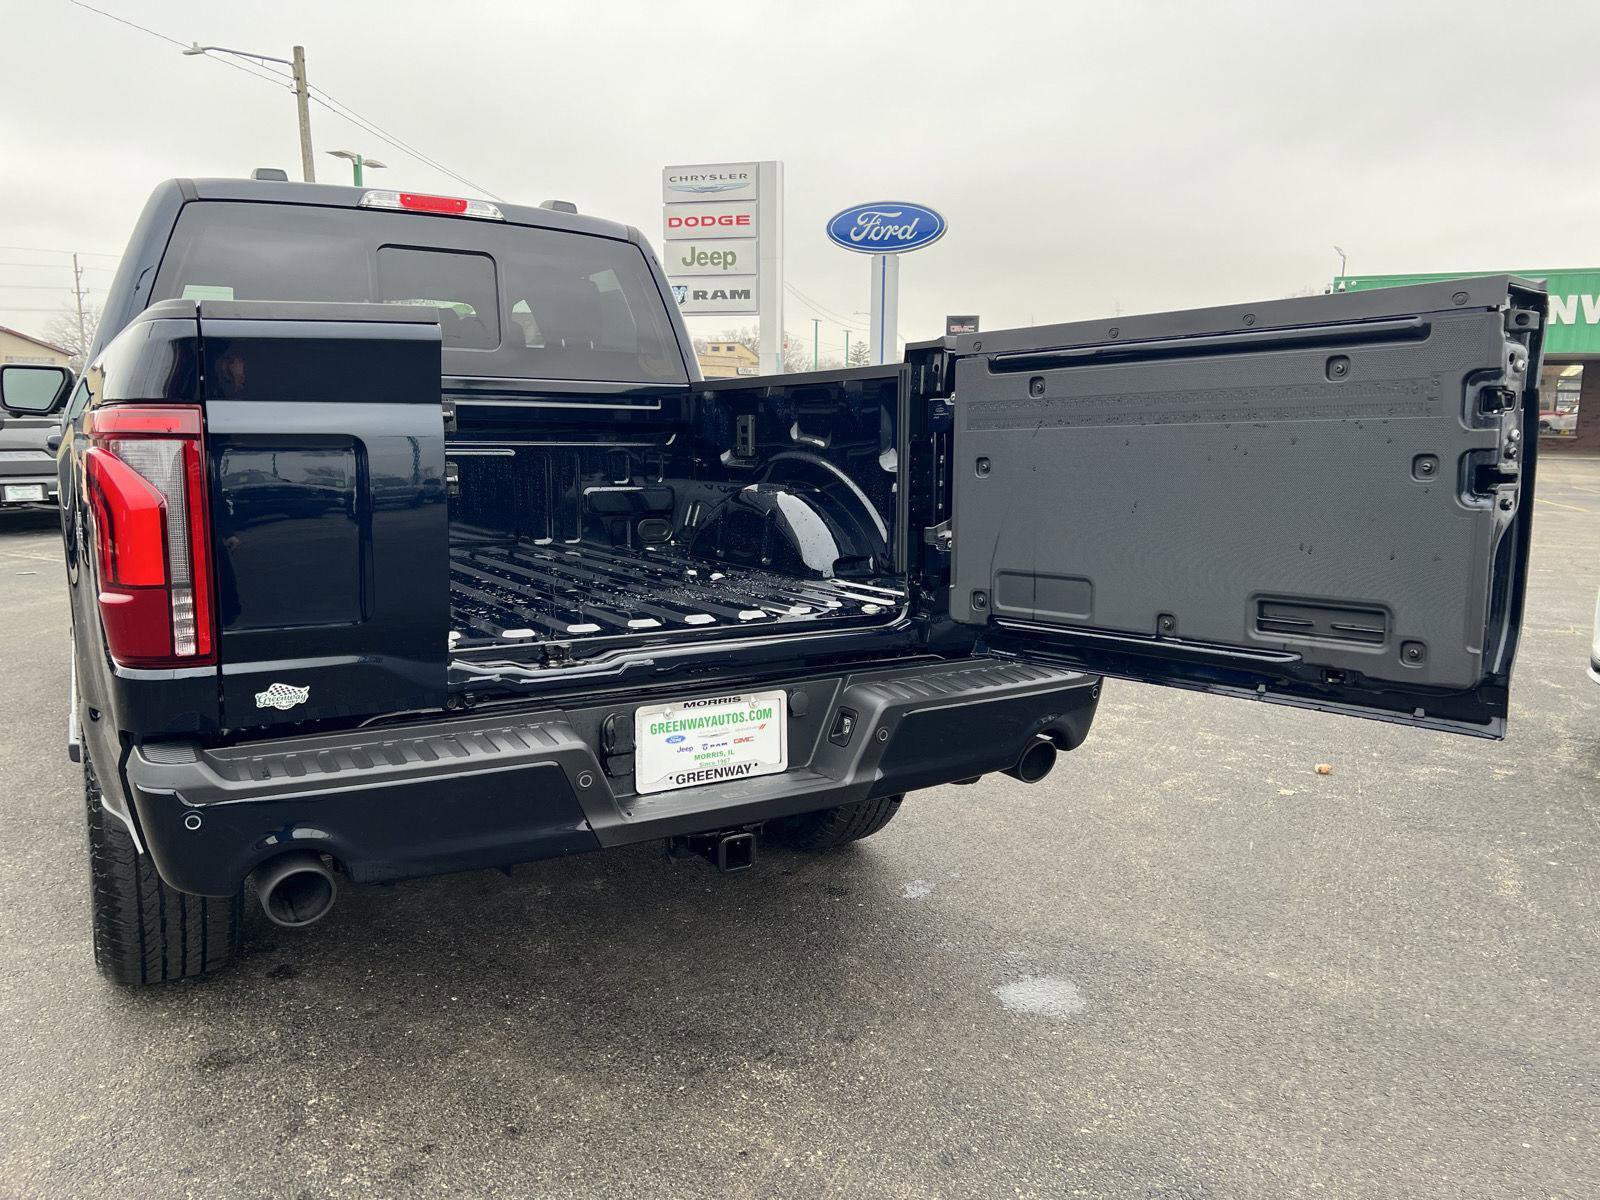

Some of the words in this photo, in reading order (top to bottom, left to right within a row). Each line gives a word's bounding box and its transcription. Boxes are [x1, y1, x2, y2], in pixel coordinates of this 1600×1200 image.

[669, 173, 749, 182] CHRYSLER
[668, 215, 751, 228] DODGE
[850, 211, 920, 241] Ford
[681, 246, 737, 270] Jeep
[693, 289, 751, 300] RAM
[683, 695, 742, 709] MORRIS
[650, 707, 773, 735] GREENWAYAUTOS.COM
[733, 736, 754, 744] GMC
[677, 745, 694, 753] Jeep
[694, 751, 727, 761] MORRIS,
[675, 763, 752, 785] GREENWAY
